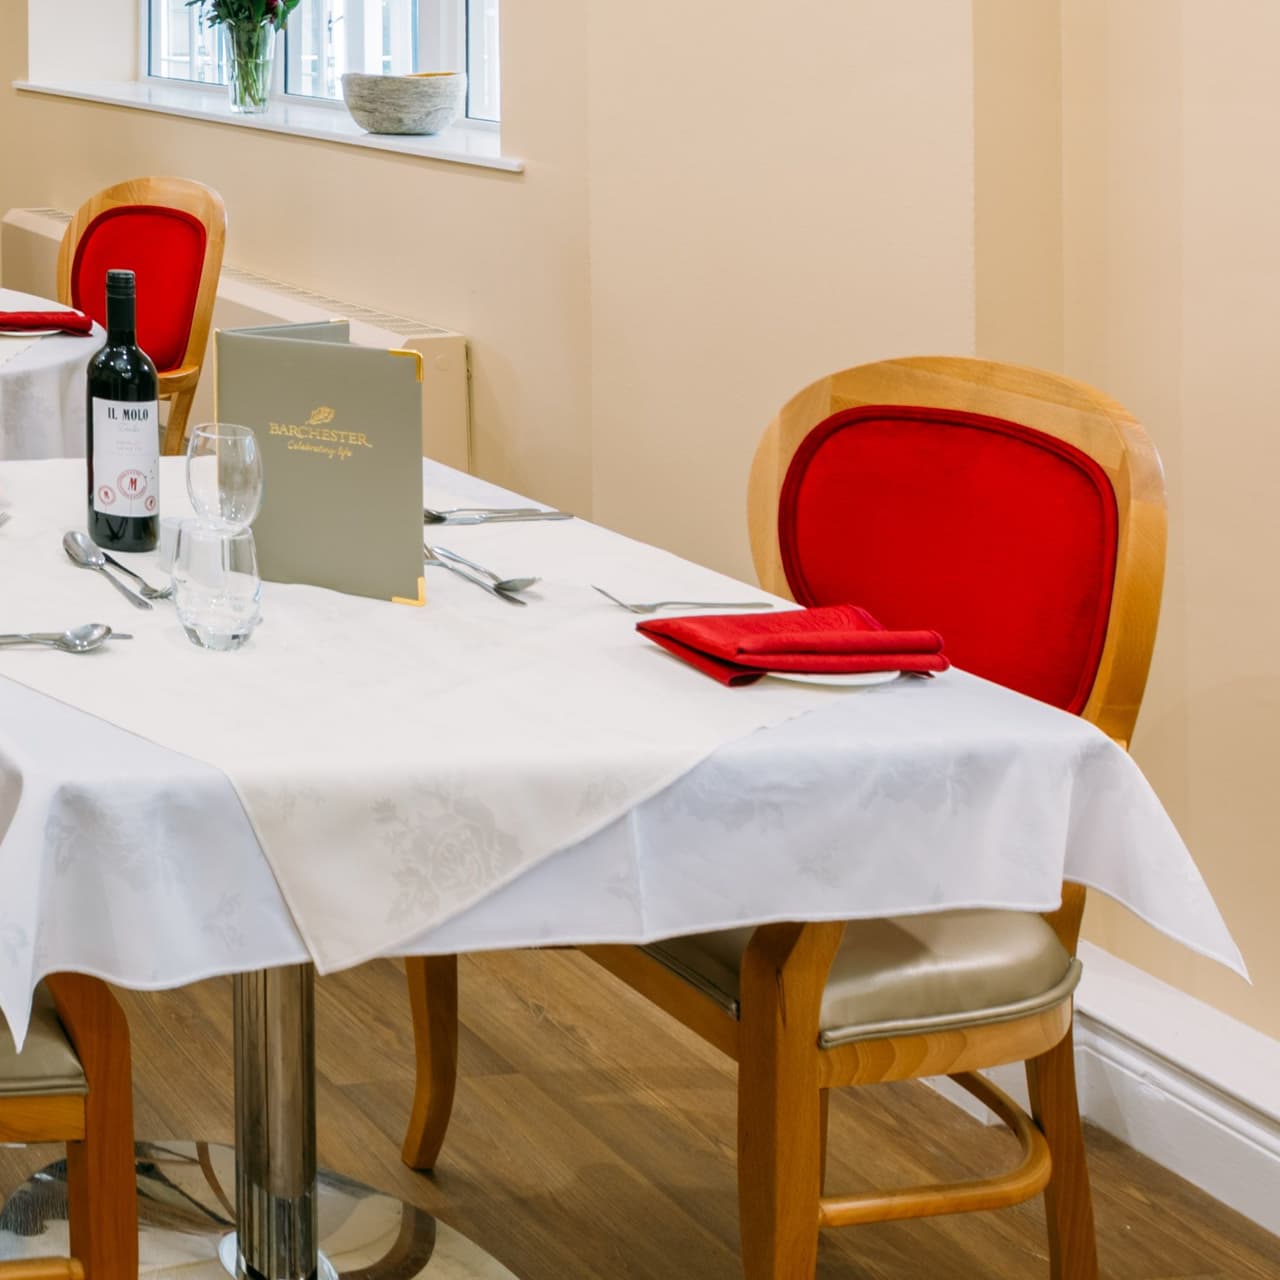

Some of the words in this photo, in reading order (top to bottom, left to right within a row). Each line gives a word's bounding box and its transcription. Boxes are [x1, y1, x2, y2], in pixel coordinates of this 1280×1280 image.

[107, 407, 117, 420] IL
[123, 408, 149, 421] MOLO
[268, 422, 373, 448] BARCHESTER
